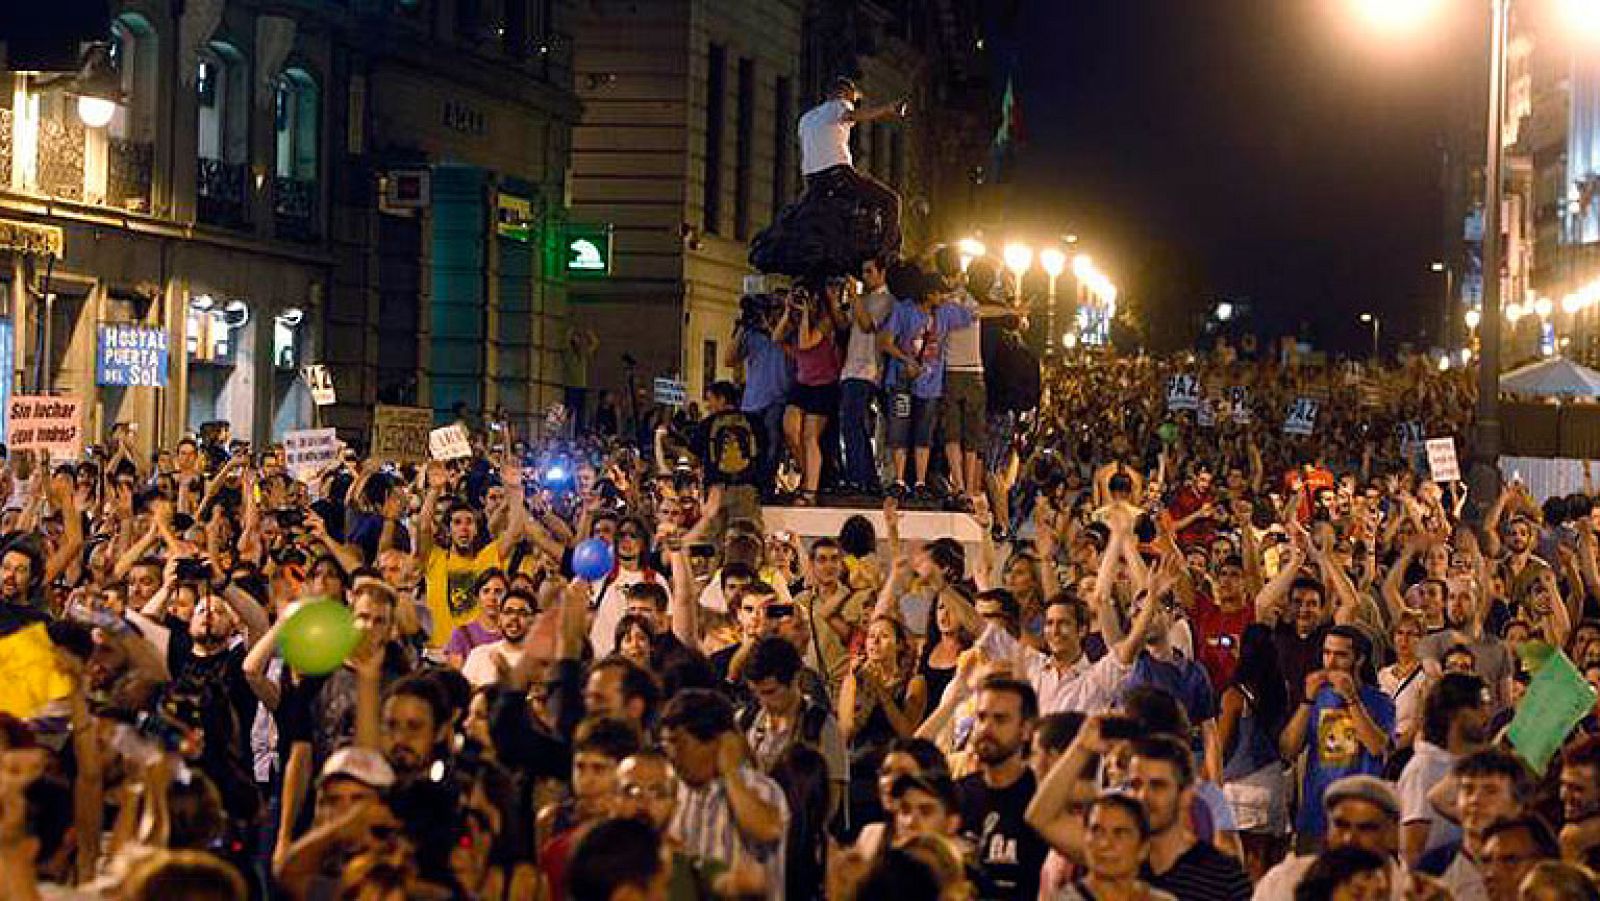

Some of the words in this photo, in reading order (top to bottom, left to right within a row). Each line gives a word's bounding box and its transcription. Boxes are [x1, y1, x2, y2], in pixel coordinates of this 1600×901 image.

[105, 326, 167, 349] HOSTAL
[105, 349, 159, 366] PUERTA
[129, 366, 161, 387] SOL
[11, 402, 32, 419] Sin
